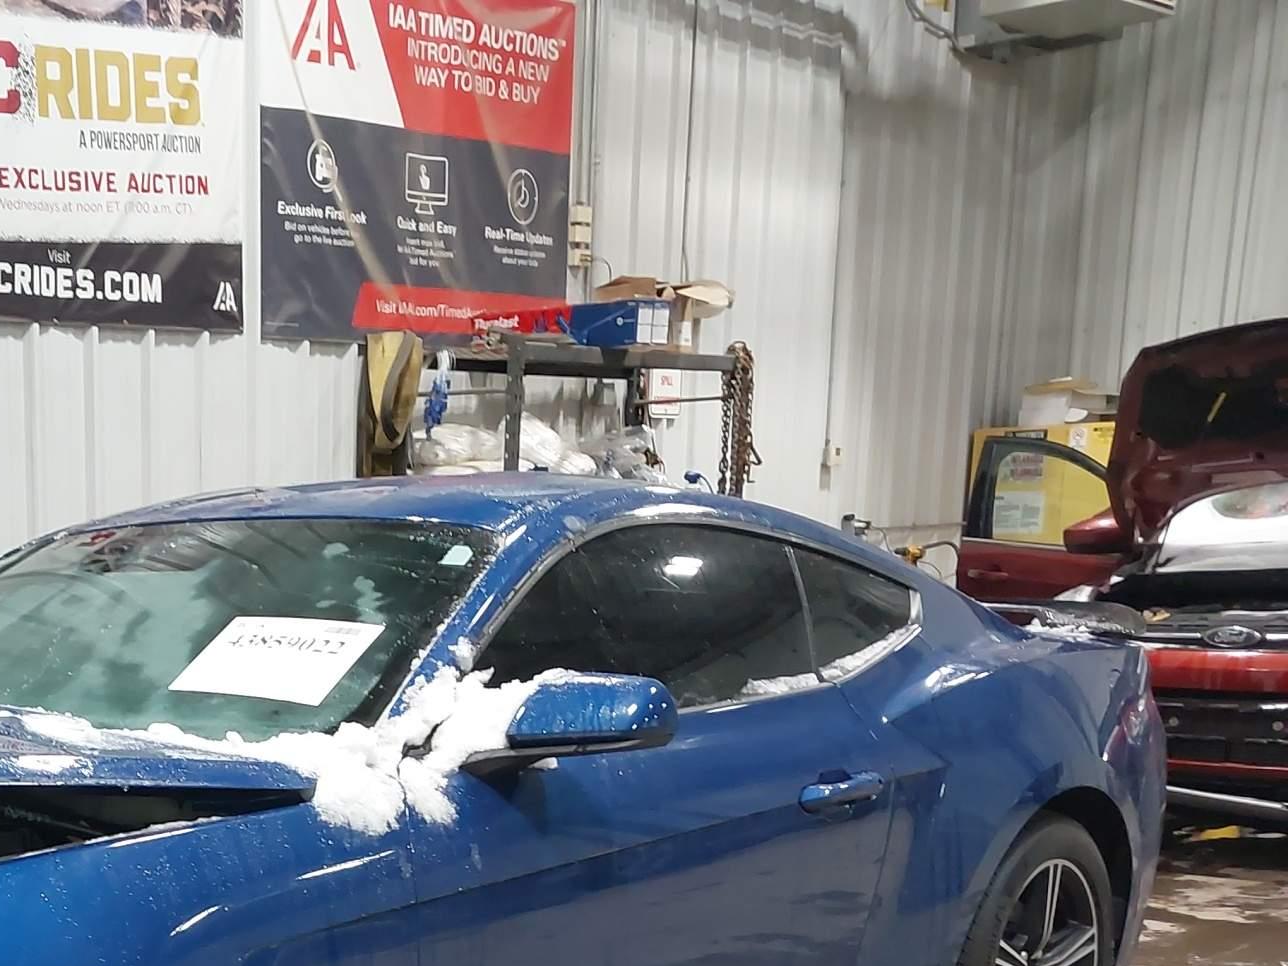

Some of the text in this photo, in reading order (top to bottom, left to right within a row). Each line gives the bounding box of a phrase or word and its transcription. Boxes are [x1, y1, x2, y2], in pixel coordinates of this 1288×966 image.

[389, 3, 416, 32] IAA
[418, 11, 474, 43] TIMED
[407, 37, 550, 82] INTRODUCING A NEW
[35, 43, 201, 126] RIDES
[414, 63, 541, 104] WAY TO BID & BUY
[79, 130, 201, 153] A POWERSPORT AUCTION
[127, 173, 209, 195] AUCTION
[62, 203, 73, 214] at
[76, 204, 104, 214] noon
[106, 200, 120, 213] ET
[277, 200, 323, 219] Exclusive
[349, 211, 367, 225] ook
[397, 216, 457, 238] Quick and Easy
[485, 226, 525, 242] Real-Time
[48, 248, 71, 264] Visit
[376, 299, 396, 314] Visit
